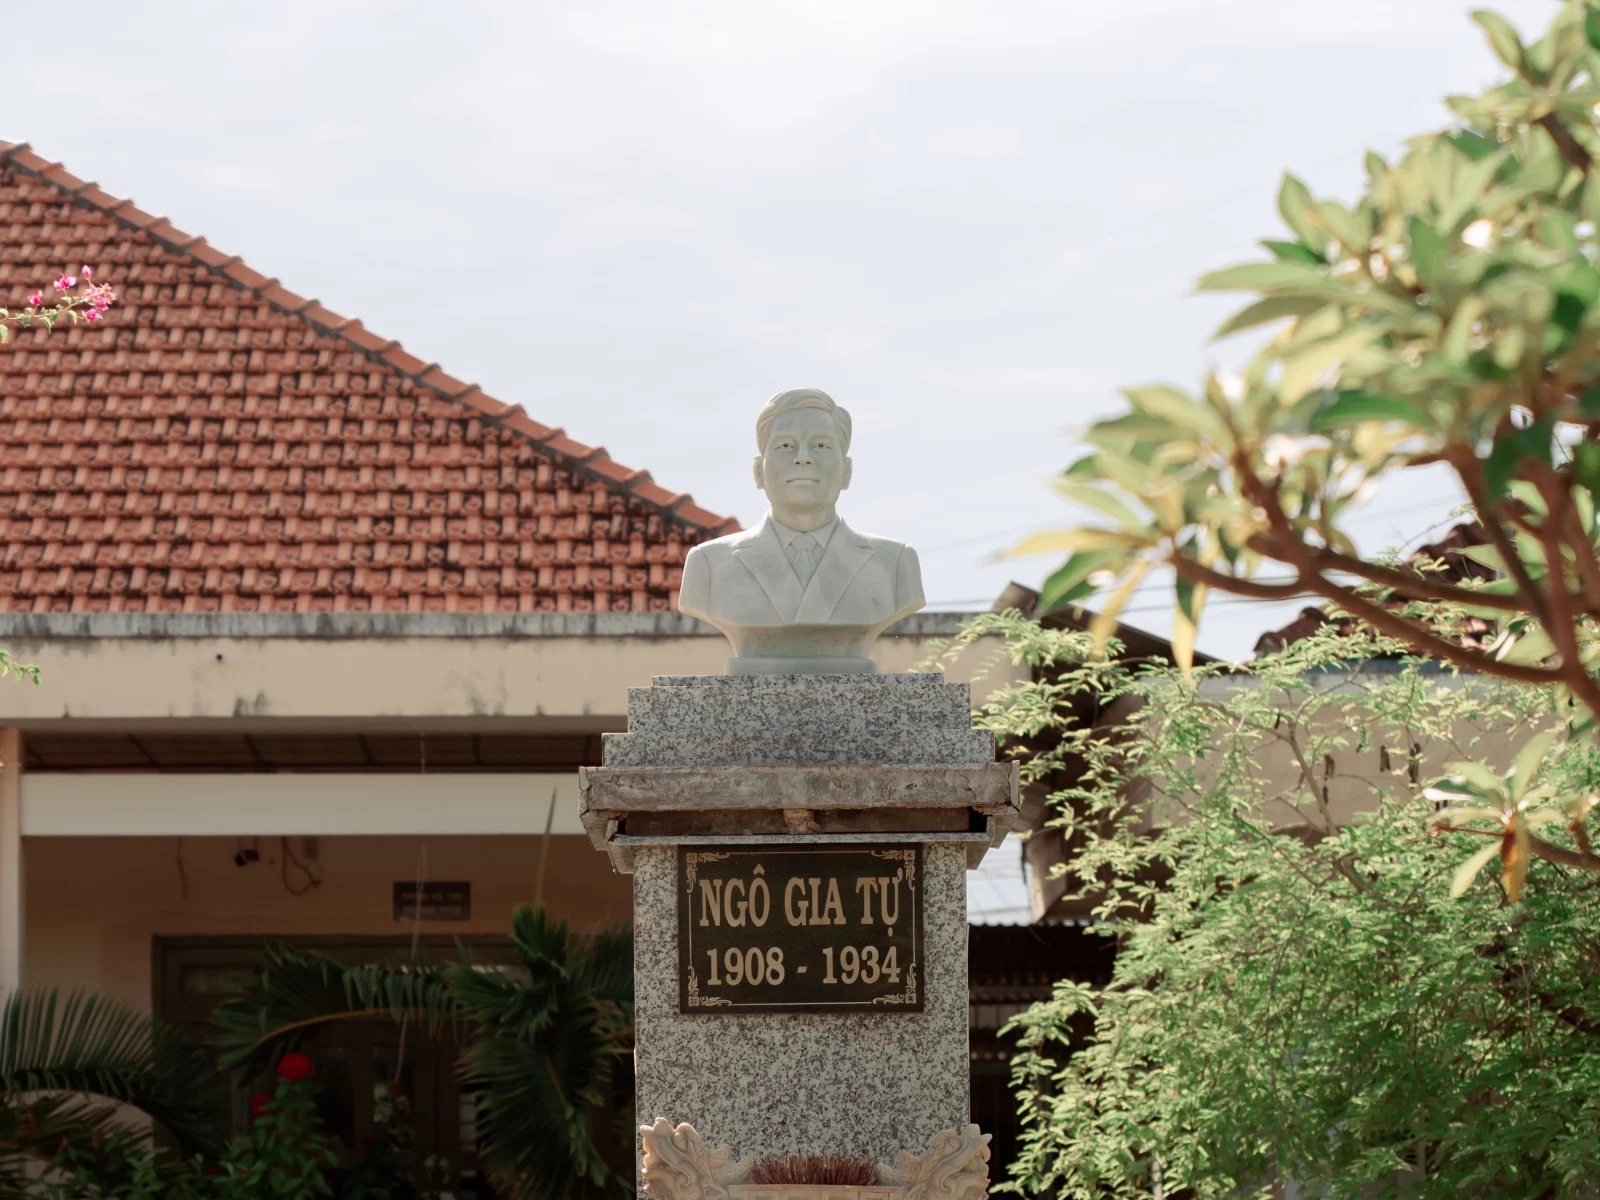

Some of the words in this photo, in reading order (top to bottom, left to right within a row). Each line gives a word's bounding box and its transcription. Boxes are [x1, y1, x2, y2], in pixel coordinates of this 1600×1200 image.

[699, 863, 771, 927] NGÔ
[784, 876, 847, 927] GIA
[855, 867, 904, 937] TỰ
[706, 946, 786, 986] 1908
[796, 965, 808, 974] -
[822, 945, 902, 985] 1934
